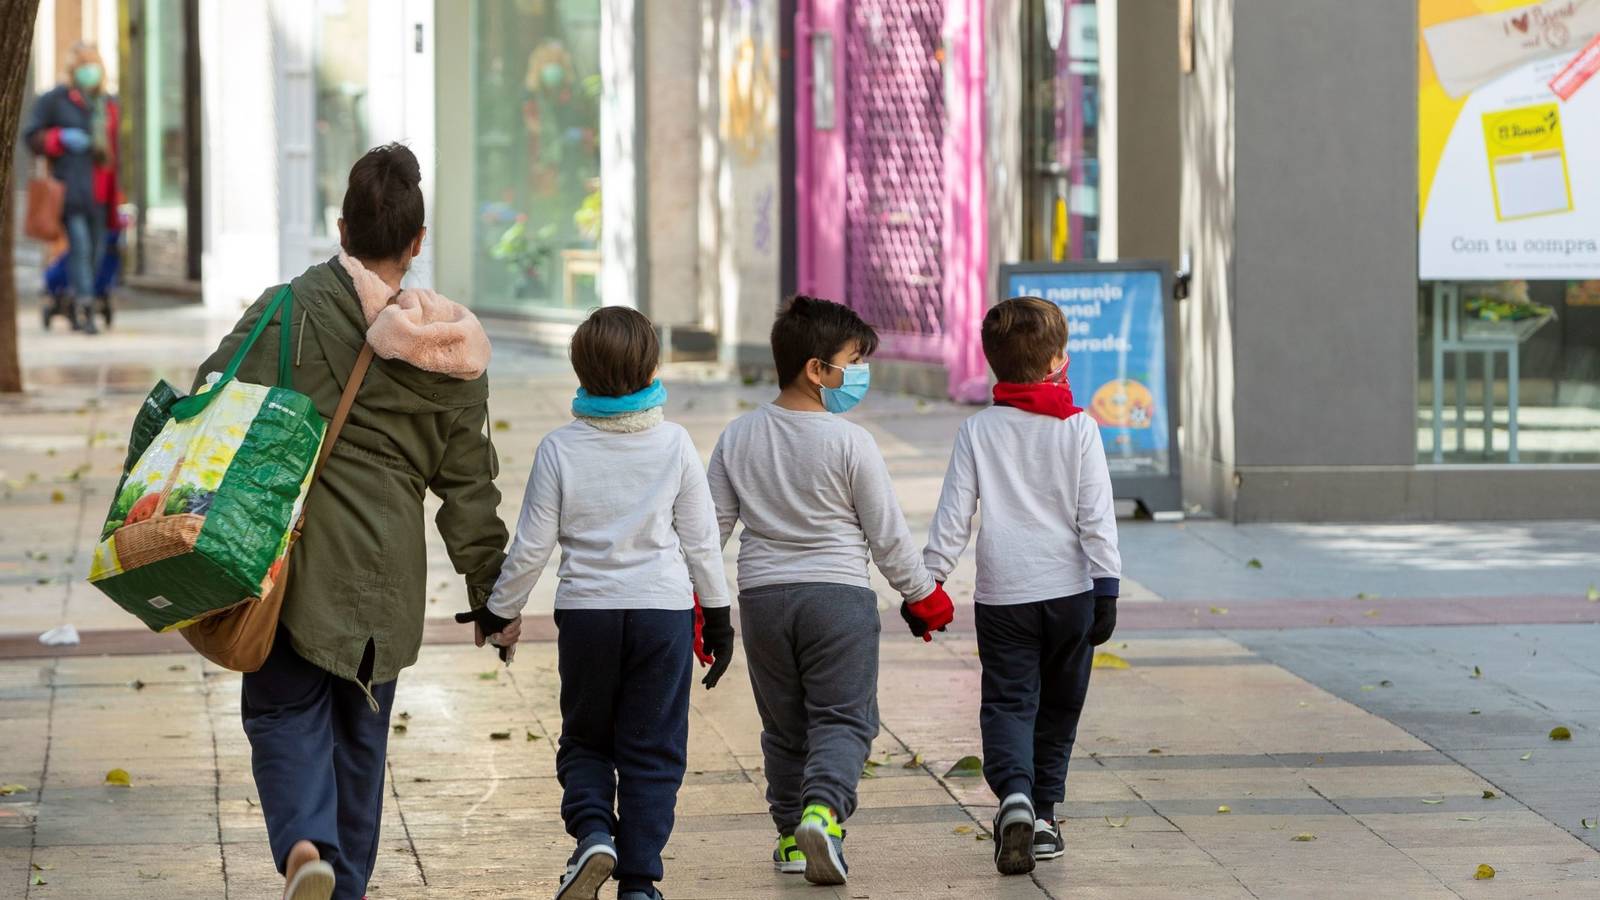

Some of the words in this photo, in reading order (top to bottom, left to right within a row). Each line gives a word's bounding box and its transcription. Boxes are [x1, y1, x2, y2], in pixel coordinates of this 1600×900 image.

[1451, 236, 1489, 252] Con
[1495, 238, 1517, 252] tu
[1523, 239, 1598, 255] compra
[1046, 283, 1124, 304] naranja
[1060, 300, 1101, 317] onal
[1068, 333, 1133, 352] orada.
